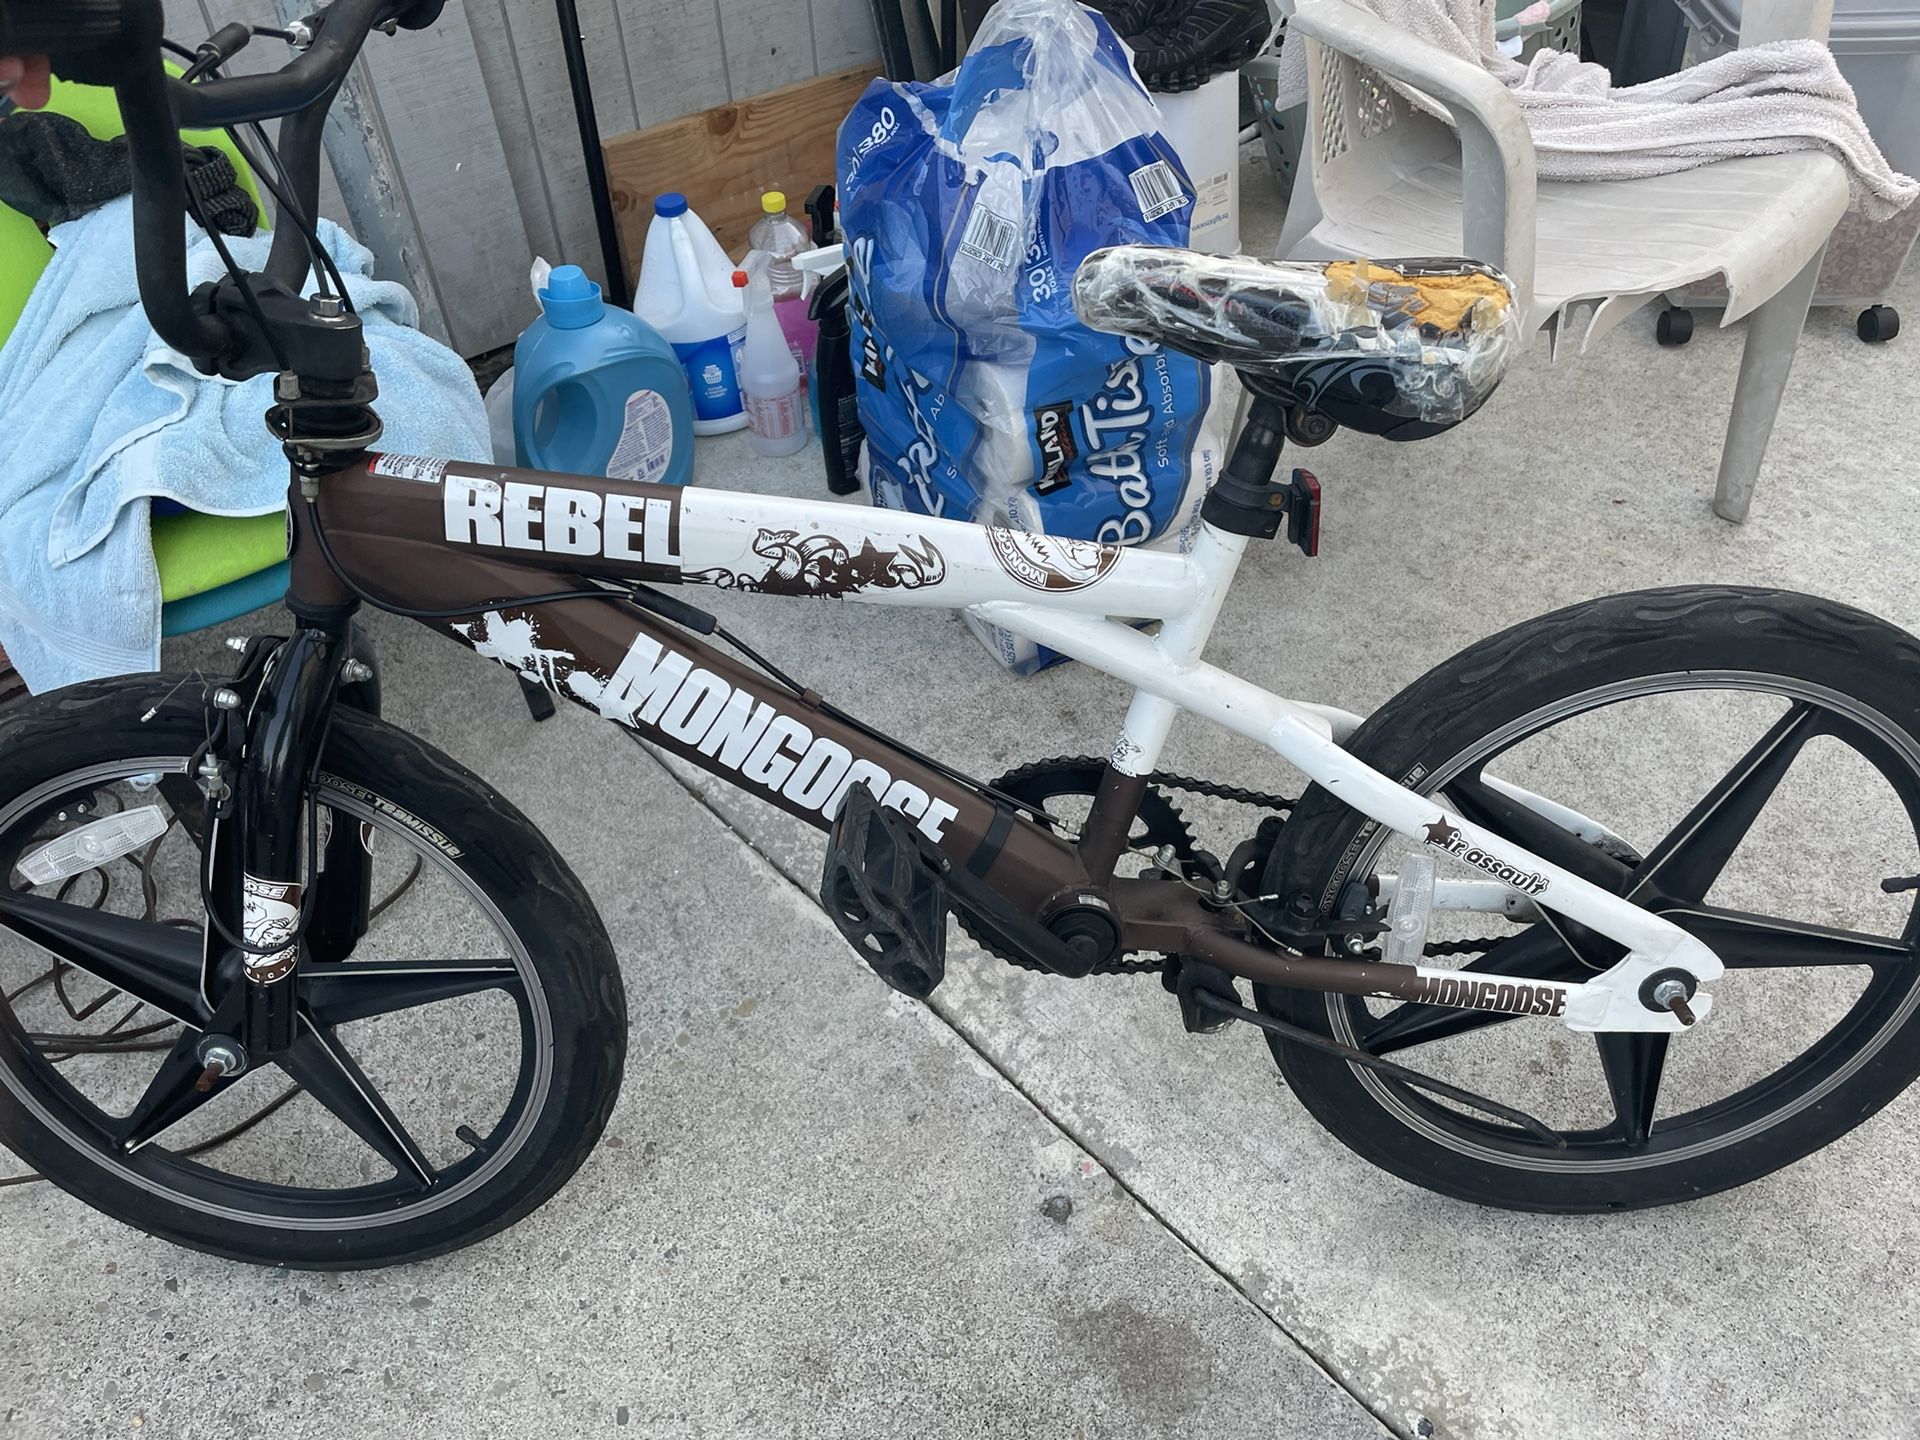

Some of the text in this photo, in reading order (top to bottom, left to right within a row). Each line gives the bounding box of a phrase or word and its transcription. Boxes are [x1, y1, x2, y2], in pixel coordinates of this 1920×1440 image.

[1029, 268, 1051, 303] 30
[1046, 265, 1059, 294] ROLLS
[444, 475, 681, 566] REBEL
[1464, 849, 1550, 895] assault
[1416, 976, 1567, 1017] MONGOOSE
